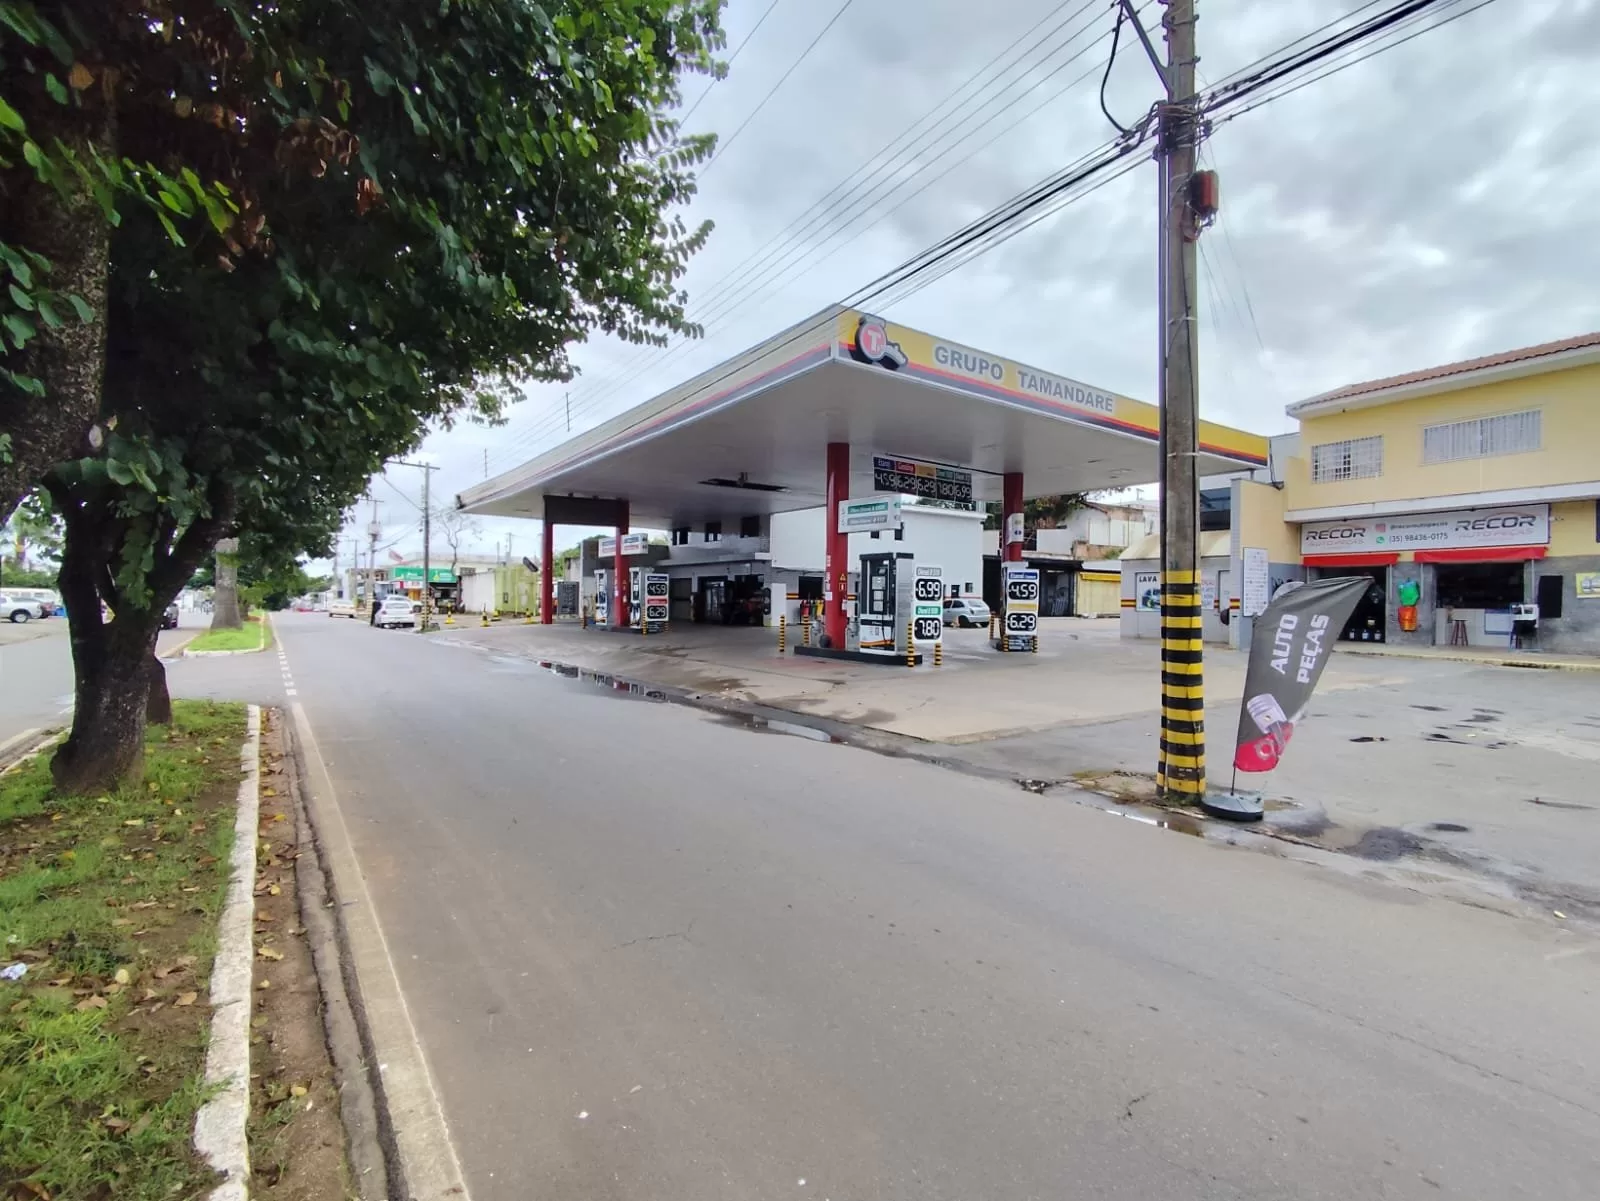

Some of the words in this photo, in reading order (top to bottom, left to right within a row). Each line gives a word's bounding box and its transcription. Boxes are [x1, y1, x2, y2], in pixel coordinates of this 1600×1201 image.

[934, 346, 1004, 380] GRUPO
[1454, 515, 1537, 531] RECOR
[1305, 527, 1367, 541] RECOR
[1388, 535, 1403, 543] (35)
[1404, 532, 1449, 542] 98436-0175
[1138, 575, 1158, 583] LAVA
[1269, 613, 1299, 675] AUTO
[1295, 613, 1331, 685] PEÇAS
